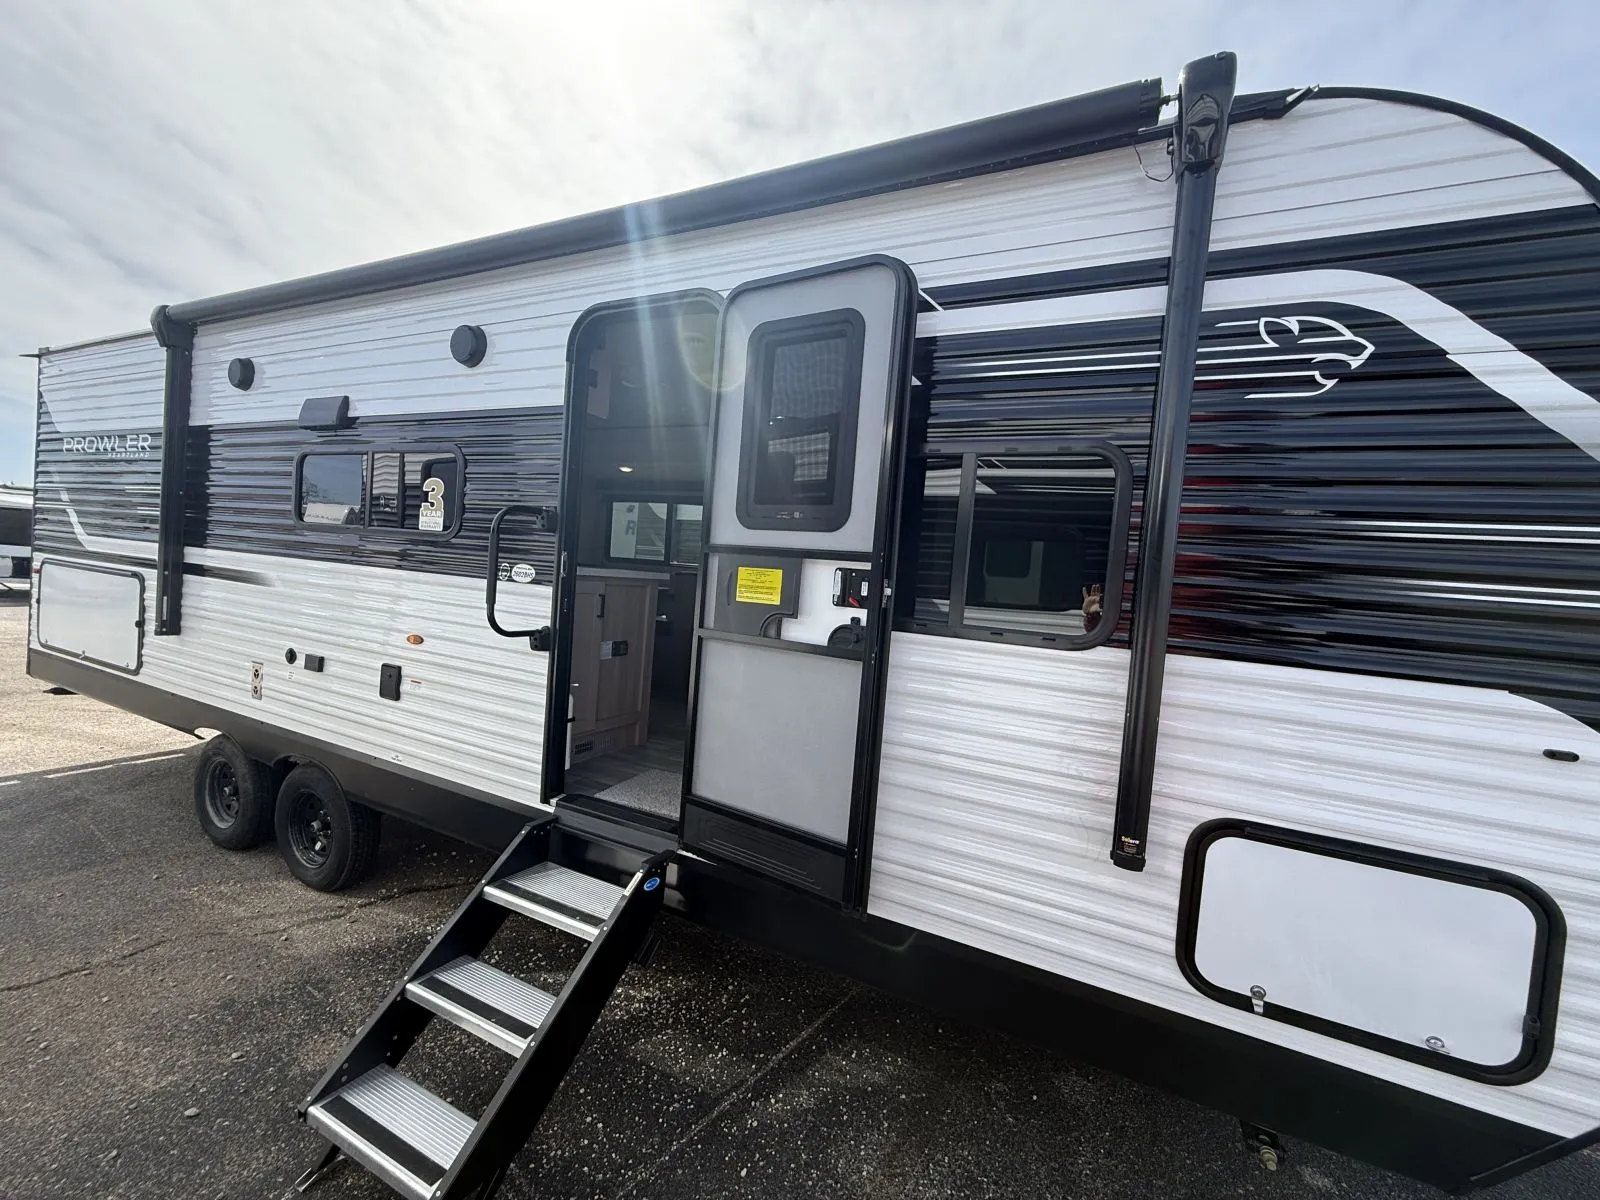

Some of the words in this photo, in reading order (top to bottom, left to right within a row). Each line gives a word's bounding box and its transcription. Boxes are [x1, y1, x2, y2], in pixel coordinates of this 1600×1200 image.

[63, 434, 152, 453] PROWLER
[422, 477, 445, 511] 3
[422, 510, 442, 518] YEAR
